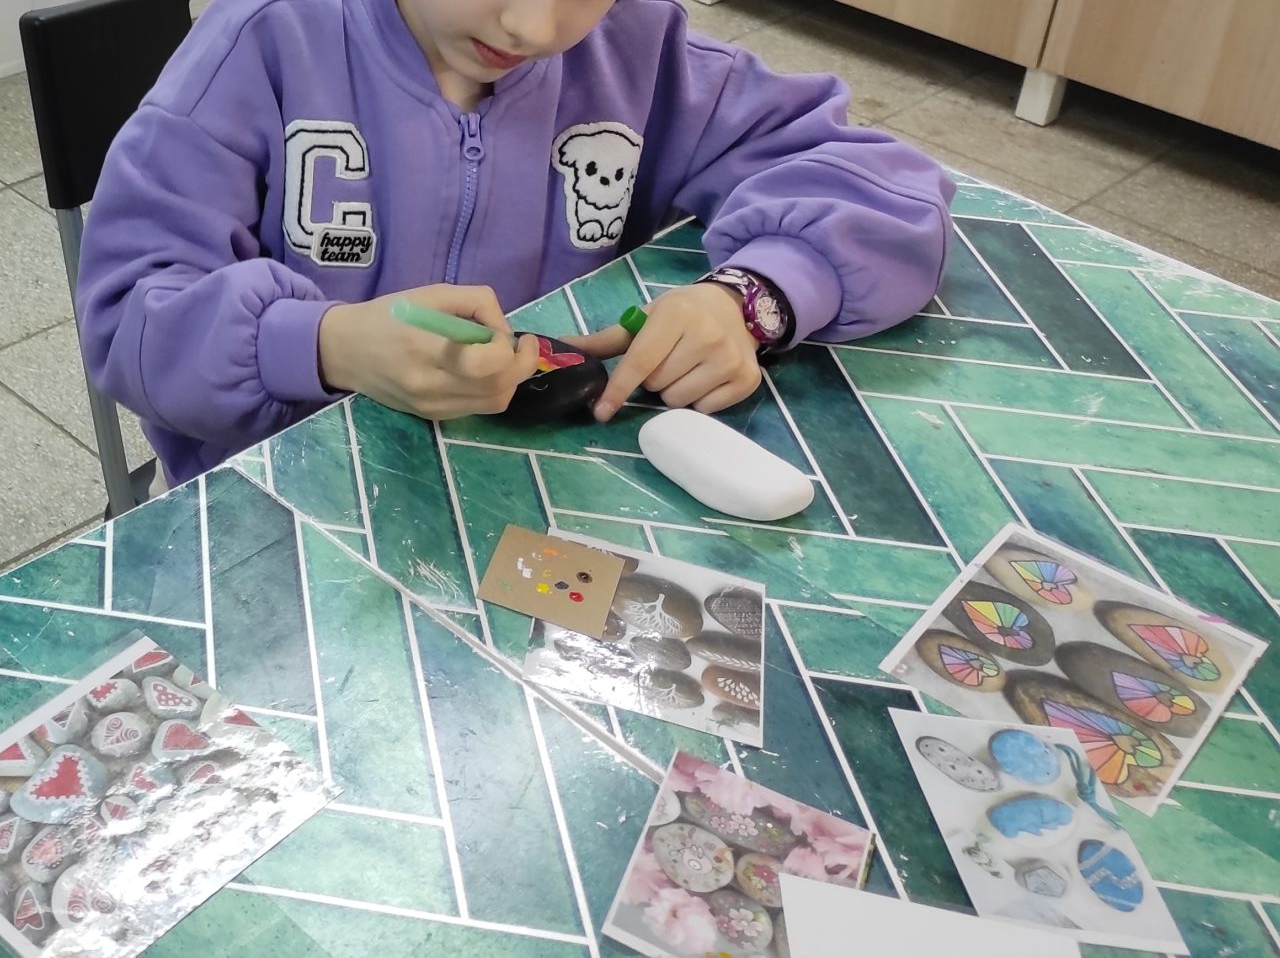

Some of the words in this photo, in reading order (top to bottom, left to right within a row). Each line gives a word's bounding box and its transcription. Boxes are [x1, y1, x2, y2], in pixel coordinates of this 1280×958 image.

[283, 119, 373, 258] C
[320, 232, 373, 254] happy
[320, 247, 363, 263] team
